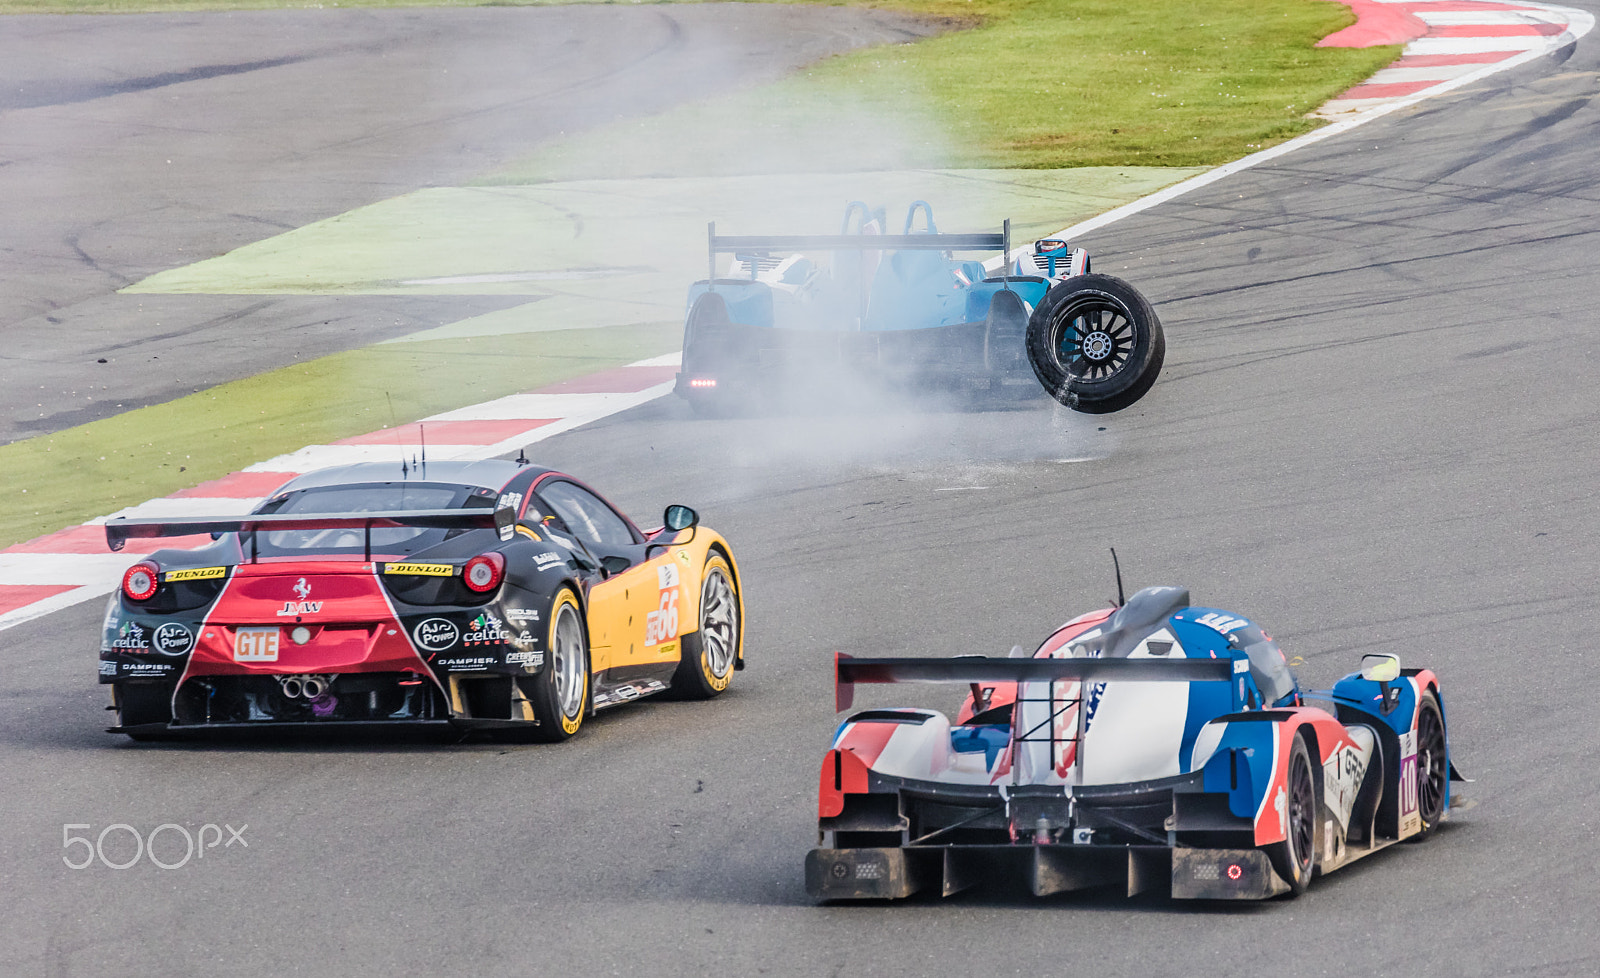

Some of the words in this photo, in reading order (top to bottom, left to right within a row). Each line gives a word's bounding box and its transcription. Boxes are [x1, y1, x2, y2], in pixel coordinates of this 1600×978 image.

[174, 569, 225, 579] DUNLOP
[396, 565, 452, 573] DUNLOP
[283, 602, 323, 613] JMW
[657, 589, 678, 641] 66
[423, 632, 455, 645] Power
[463, 629, 510, 642] celtic
[112, 637, 150, 649] celtic
[236, 631, 277, 656] GTE
[1402, 759, 1416, 813] 10
